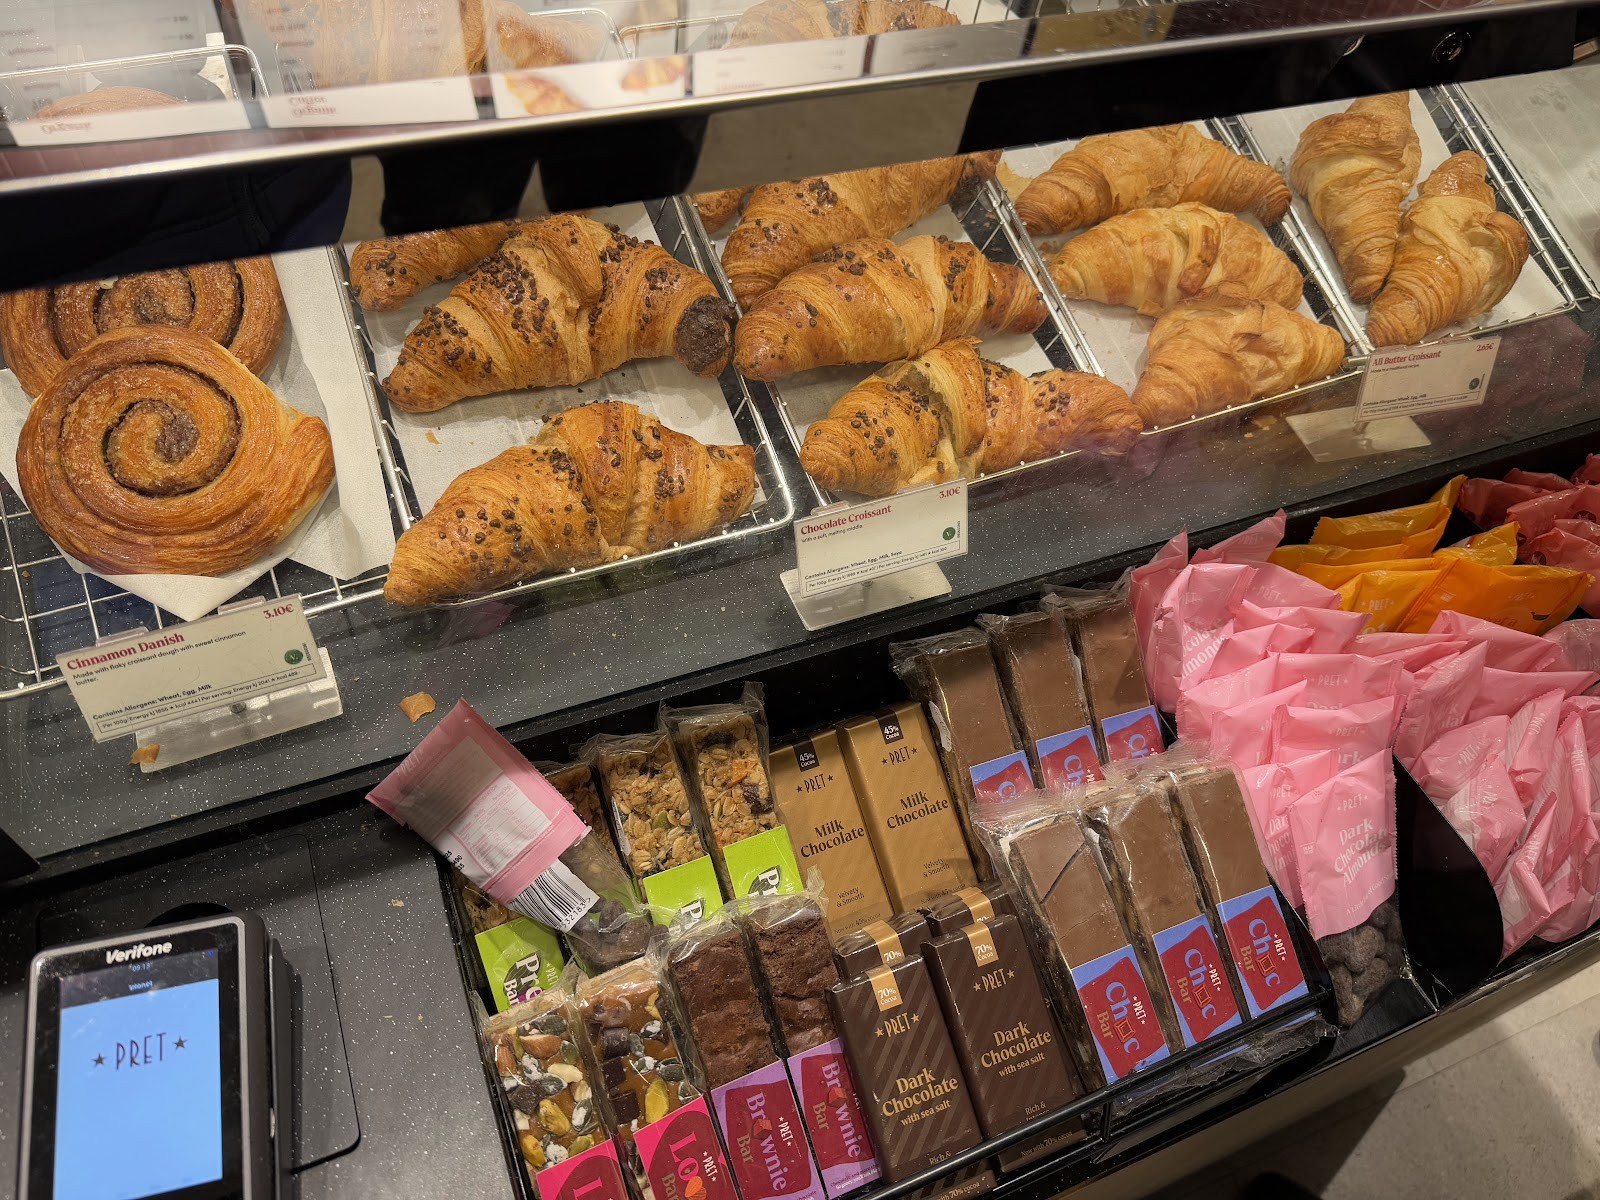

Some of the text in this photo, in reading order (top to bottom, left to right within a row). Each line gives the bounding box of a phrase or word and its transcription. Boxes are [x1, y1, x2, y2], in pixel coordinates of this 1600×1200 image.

[1372, 350, 1441, 366] All Butter Croissant
[939, 486, 961, 499] 3.10€
[800, 505, 892, 535] Chocolate Croissant
[263, 603, 294, 620] 3.10€
[67, 633, 185, 671] Cinnamon Danish
[73, 630, 247, 680] Made with flaky croissant dough with sweet cinnamon
[93, 709, 123, 720] Contains
[124, 699, 158, 712] Allergens:
[158, 692, 182, 703] Wheat,
[198, 683, 212, 692] Milk
[129, 713, 149, 721] Energy
[233, 684, 252, 693] Energy
[884, 724, 899, 735] 45%
[885, 731, 900, 740] Cocoa
[800, 752, 815, 763] 45%
[800, 759, 816, 768] Cocoa
[889, 746, 911, 766] PRET
[804, 773, 827, 793] PRET
[900, 791, 930, 811] Milk
[1342, 792, 1364, 812] PRET
[886, 798, 949, 829] Chocolate
[814, 819, 845, 840] Milk
[1339, 818, 1374, 846] Dark
[800, 826, 865, 858] Chocolate
[923, 857, 945, 870] Velvety
[929, 862, 950, 876] Smooth
[837, 886, 859, 899] Velvety
[842, 891, 865, 906] Smooth
[105, 941, 173, 965] Verifone
[883, 950, 902, 963] 70%
[974, 943, 993, 955] 70%
[977, 951, 994, 961] Cocoa
[1273, 938, 1287, 957] PRET
[1240, 944, 1256, 972] Bar
[982, 968, 1008, 992] PRET
[1208, 968, 1223, 987] PRET
[877, 987, 897, 999] 70%
[880, 994, 897, 1006] Cocoa
[1177, 976, 1194, 1005] Bar
[1132, 1001, 1147, 1021] PRET
[884, 1013, 910, 1038] PRET
[993, 1020, 1031, 1047] Dark
[1097, 1010, 1114, 1039] Bar
[115, 1032, 167, 1070] PRET
[980, 1029, 1052, 1069] Chocolate
[998, 1052, 1045, 1078] with sea salt
[895, 1067, 936, 1095] Dark
[882, 1077, 959, 1117] Chocolate
[812, 1101, 830, 1131] Bar
[900, 1099, 952, 1127] with sea salt
[1025, 1102, 1040, 1116] Rich
[778, 1121, 794, 1142] PRET
[1043, 1137, 1057, 1148] 70%
[1057, 1131, 1073, 1142] cocoa
[737, 1134, 754, 1164] Bar
[929, 1152, 945, 1166] Rich
[703, 1156, 718, 1177] PRET
[949, 1186, 964, 1200] 70%
[964, 1181, 981, 1194] cocoa
